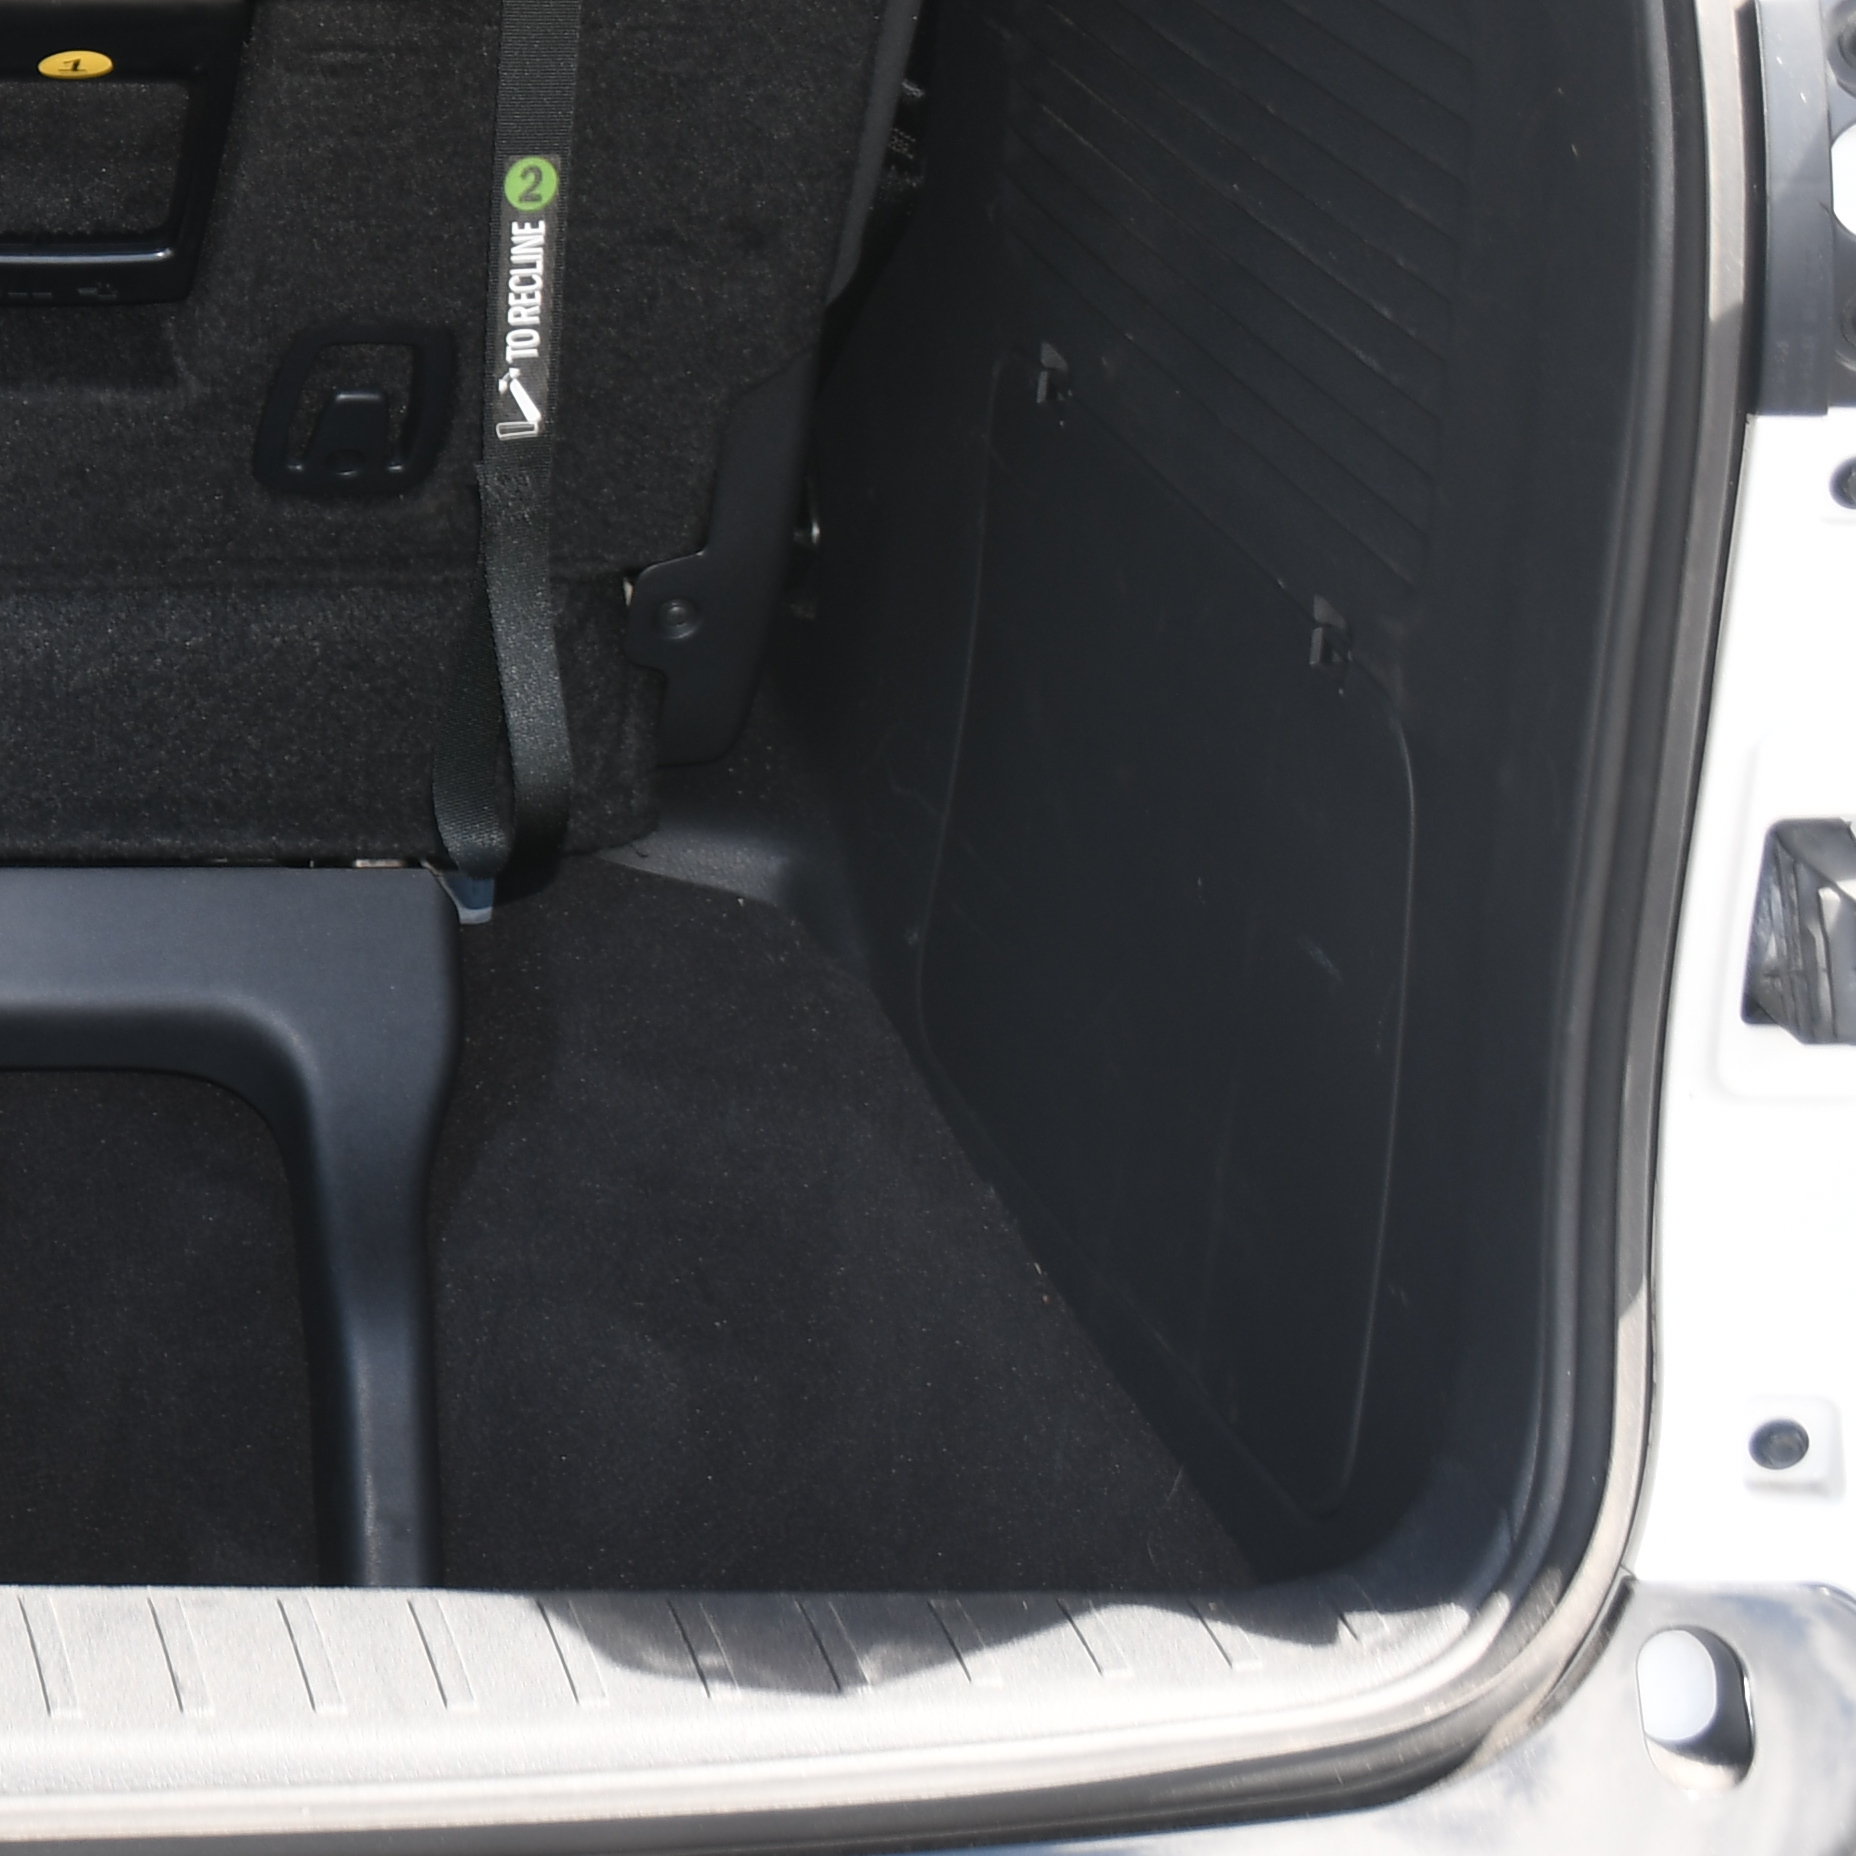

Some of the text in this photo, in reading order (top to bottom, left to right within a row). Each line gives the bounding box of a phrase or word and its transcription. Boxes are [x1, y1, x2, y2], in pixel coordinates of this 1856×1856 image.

[518, 167, 544, 201] 2
[507, 220, 547, 363] TO RECLINE
